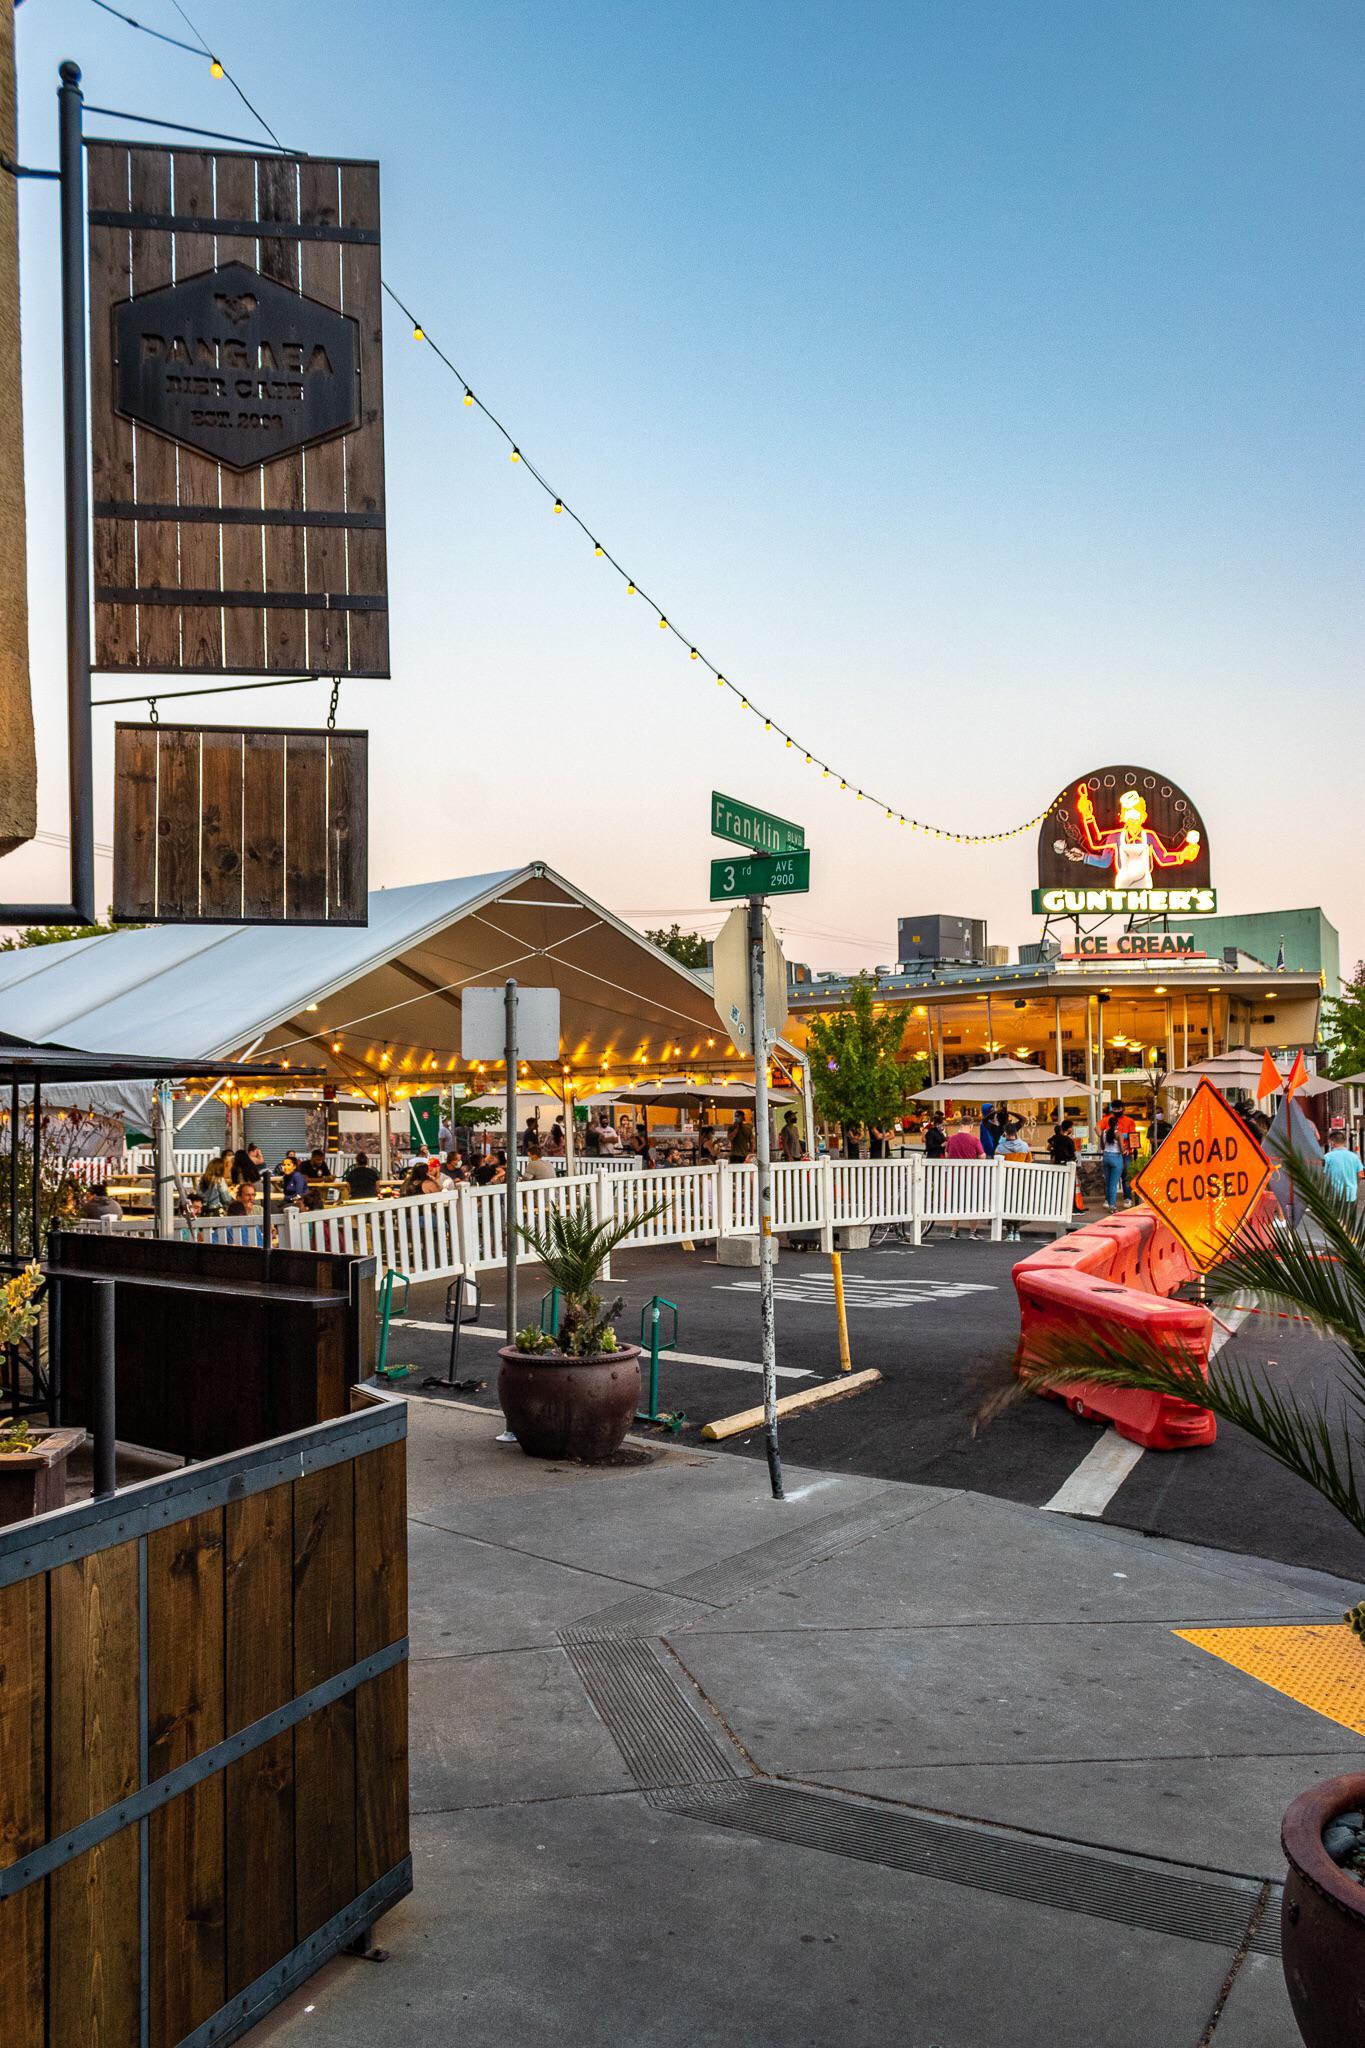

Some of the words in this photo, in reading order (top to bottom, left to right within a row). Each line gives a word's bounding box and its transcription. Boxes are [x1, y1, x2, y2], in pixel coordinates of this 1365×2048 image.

[140, 333, 334, 375] PANGAEA
[165, 374, 227, 397] BIER
[716, 801, 780, 851] Franklin
[787, 830, 802, 846] BLVD
[775, 860, 793, 872] AVE
[771, 873, 795, 886] 2900
[1042, 888, 1215, 912] GUNTHER'S
[1074, 936, 1107, 954] ICE
[1117, 935, 1195, 954] CREAM
[1178, 1136, 1238, 1166] ROAD
[1165, 1171, 1249, 1204] CLOSED
